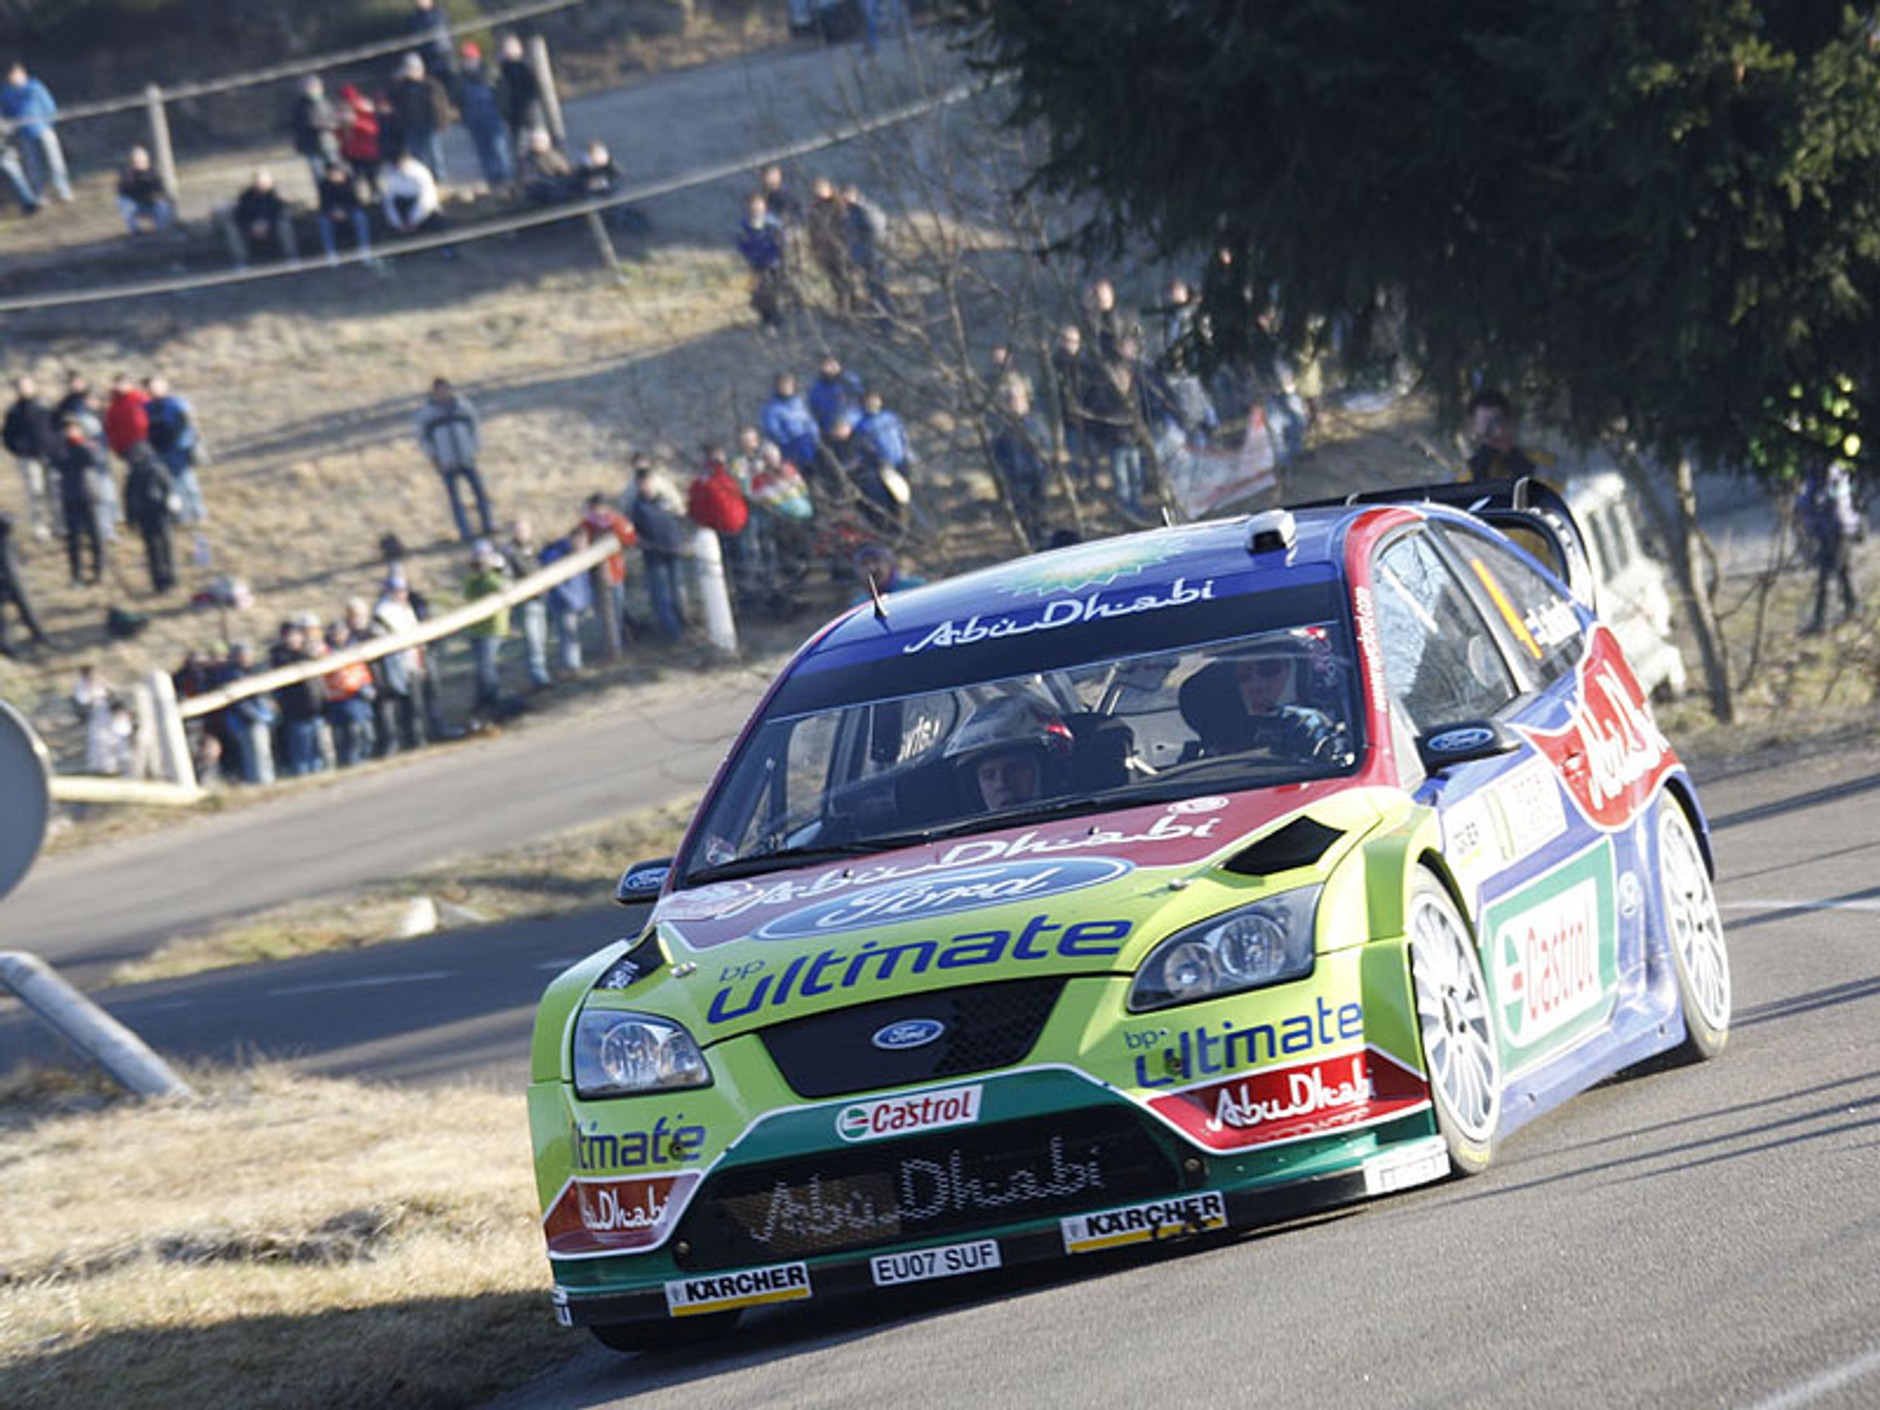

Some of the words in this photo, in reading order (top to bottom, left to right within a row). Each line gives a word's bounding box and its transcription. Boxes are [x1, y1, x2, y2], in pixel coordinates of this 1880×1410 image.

[815, 866, 1064, 927] Ford
[706, 914, 1133, 1025] ultimate
[718, 959, 767, 983] bp
[1525, 892, 1594, 1021] Castrol
[1135, 997, 1364, 1089] ultimate
[871, 1091, 971, 1133] Castrol
[876, 1252, 937, 1281] EU07
[945, 1245, 993, 1273] SUF
